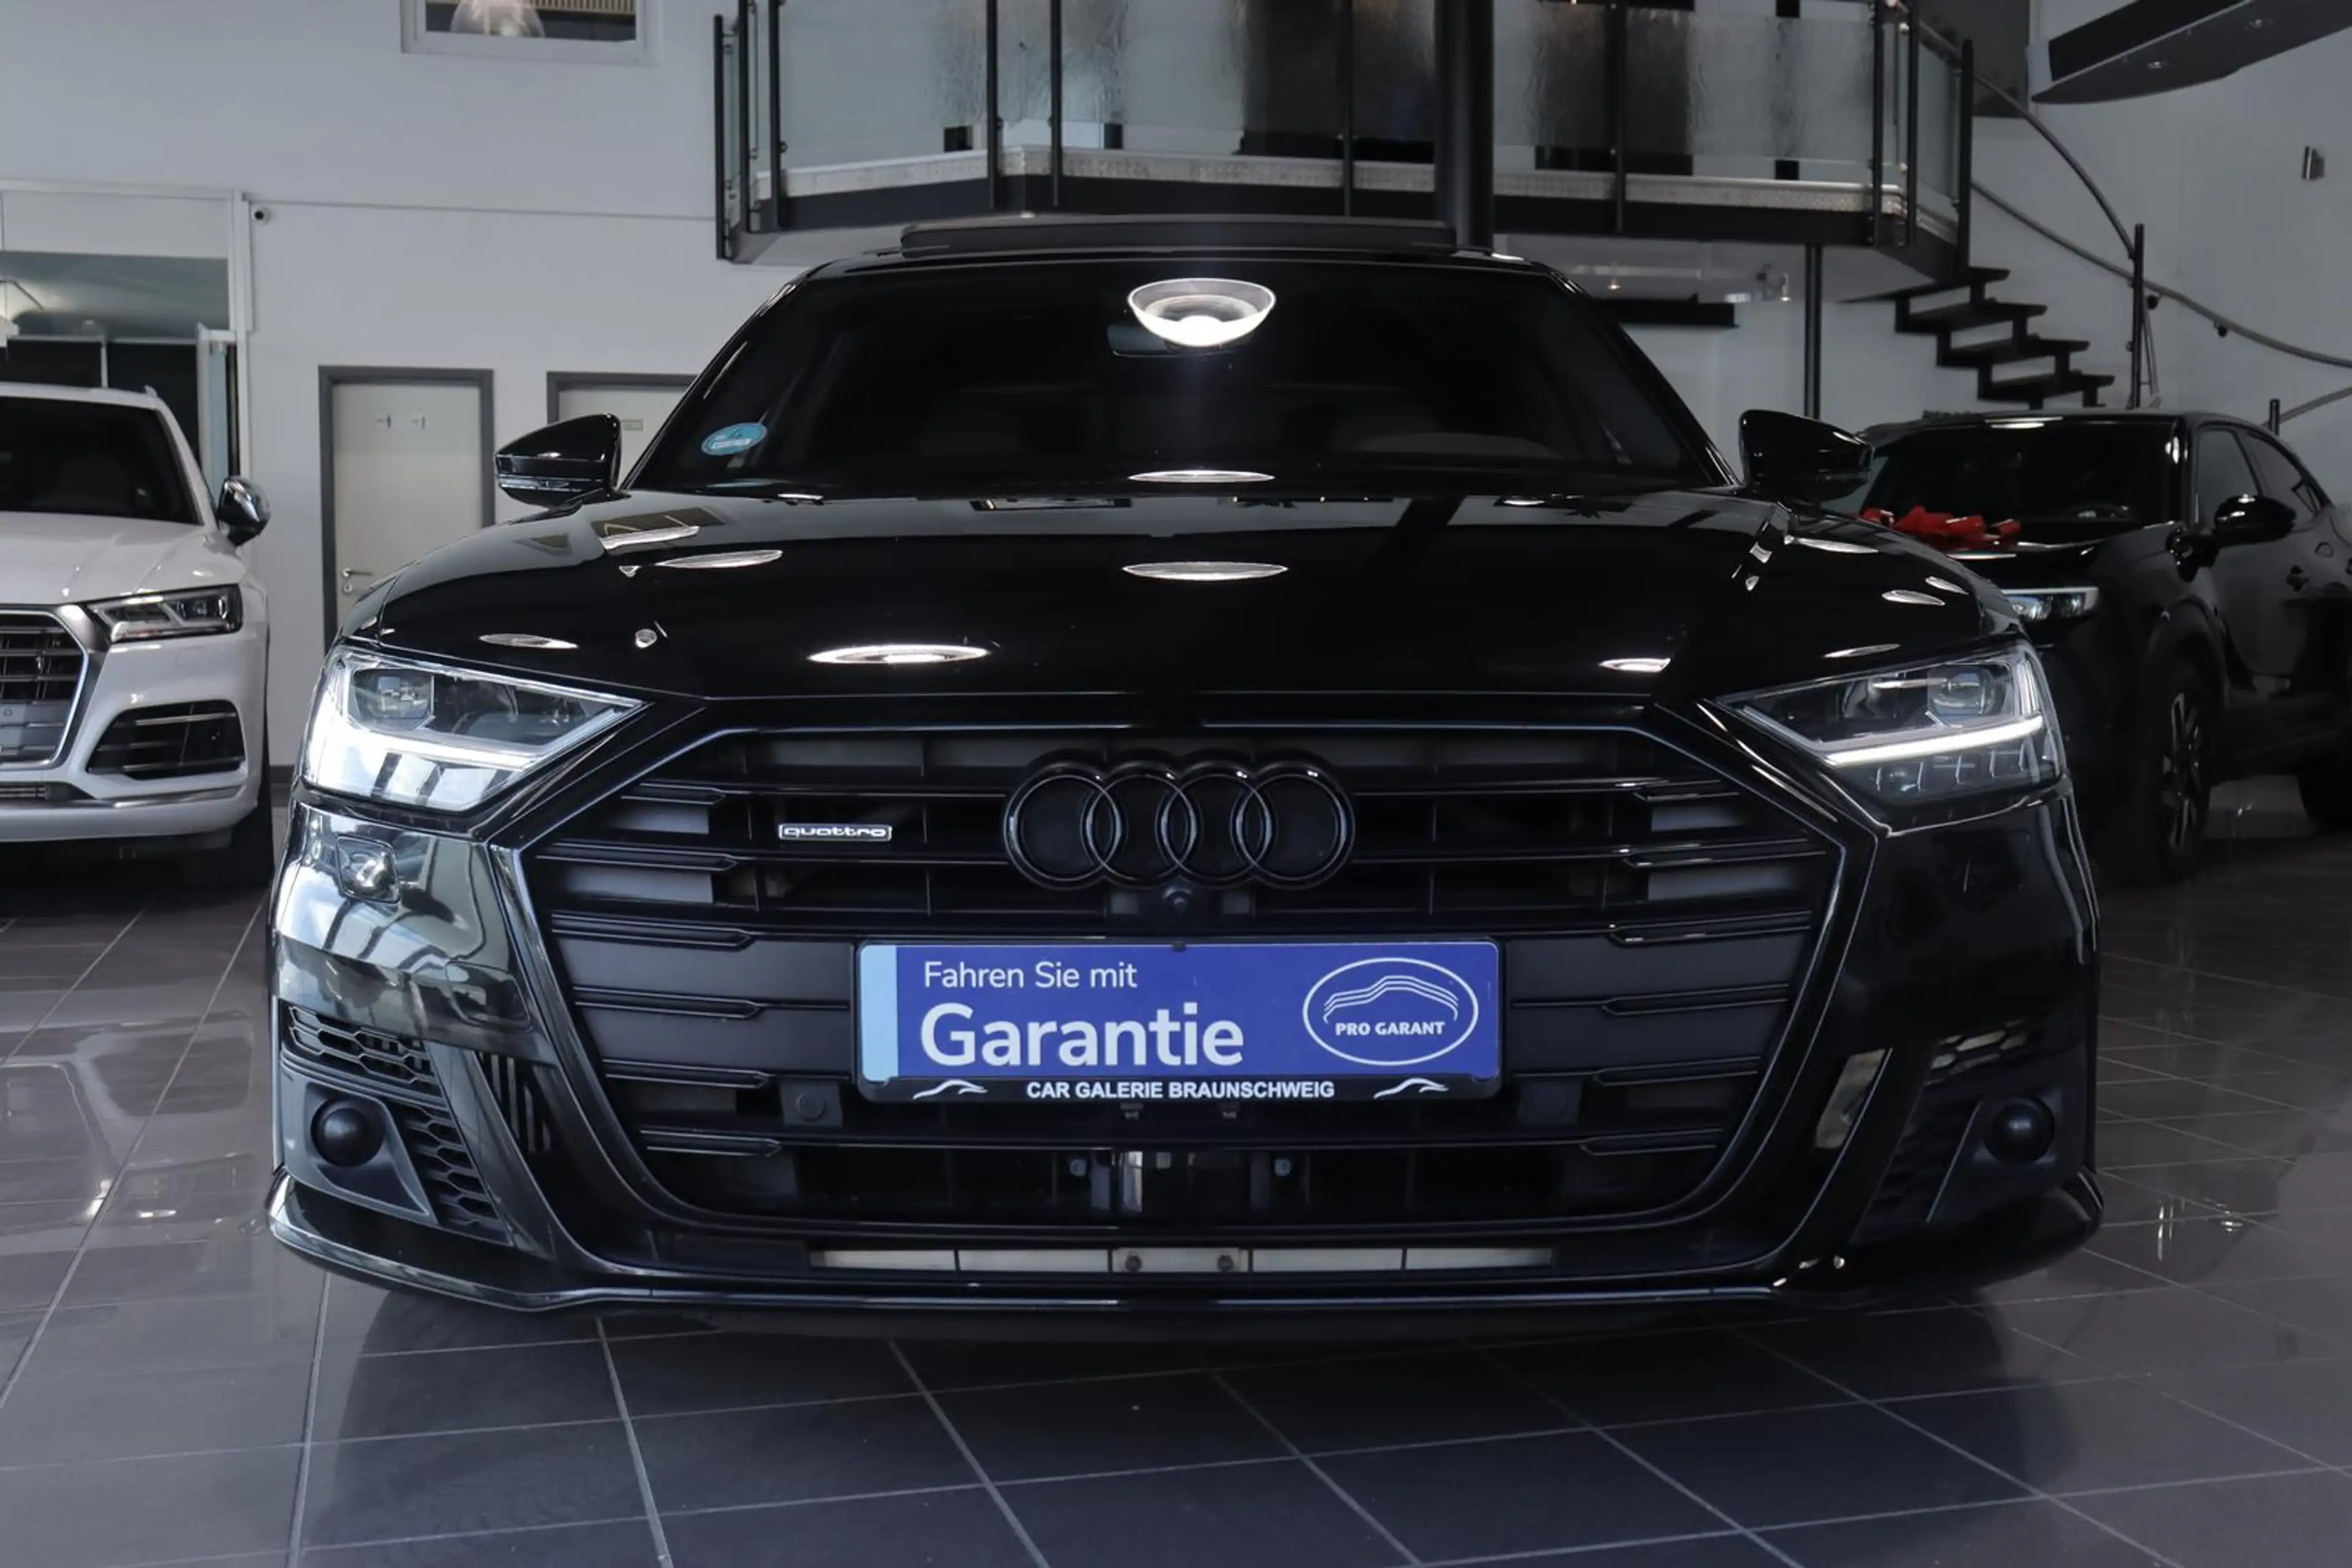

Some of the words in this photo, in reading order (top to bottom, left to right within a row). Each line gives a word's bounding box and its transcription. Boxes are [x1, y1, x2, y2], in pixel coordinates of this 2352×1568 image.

[783, 826, 887, 839] quattro
[924, 960, 1025, 989] Fahren
[1035, 960, 1080, 989] Sie
[1090, 960, 1138, 989] mit
[920, 1001, 1245, 1067] Garantie
[1335, 1020, 1371, 1036] PRO
[1374, 1020, 1446, 1036] GARANT
[1027, 1081, 1071, 1099] CAR
[1075, 1081, 1164, 1099] GALERIE
[1168, 1081, 1335, 1099] BRAUNSCHWEIG
